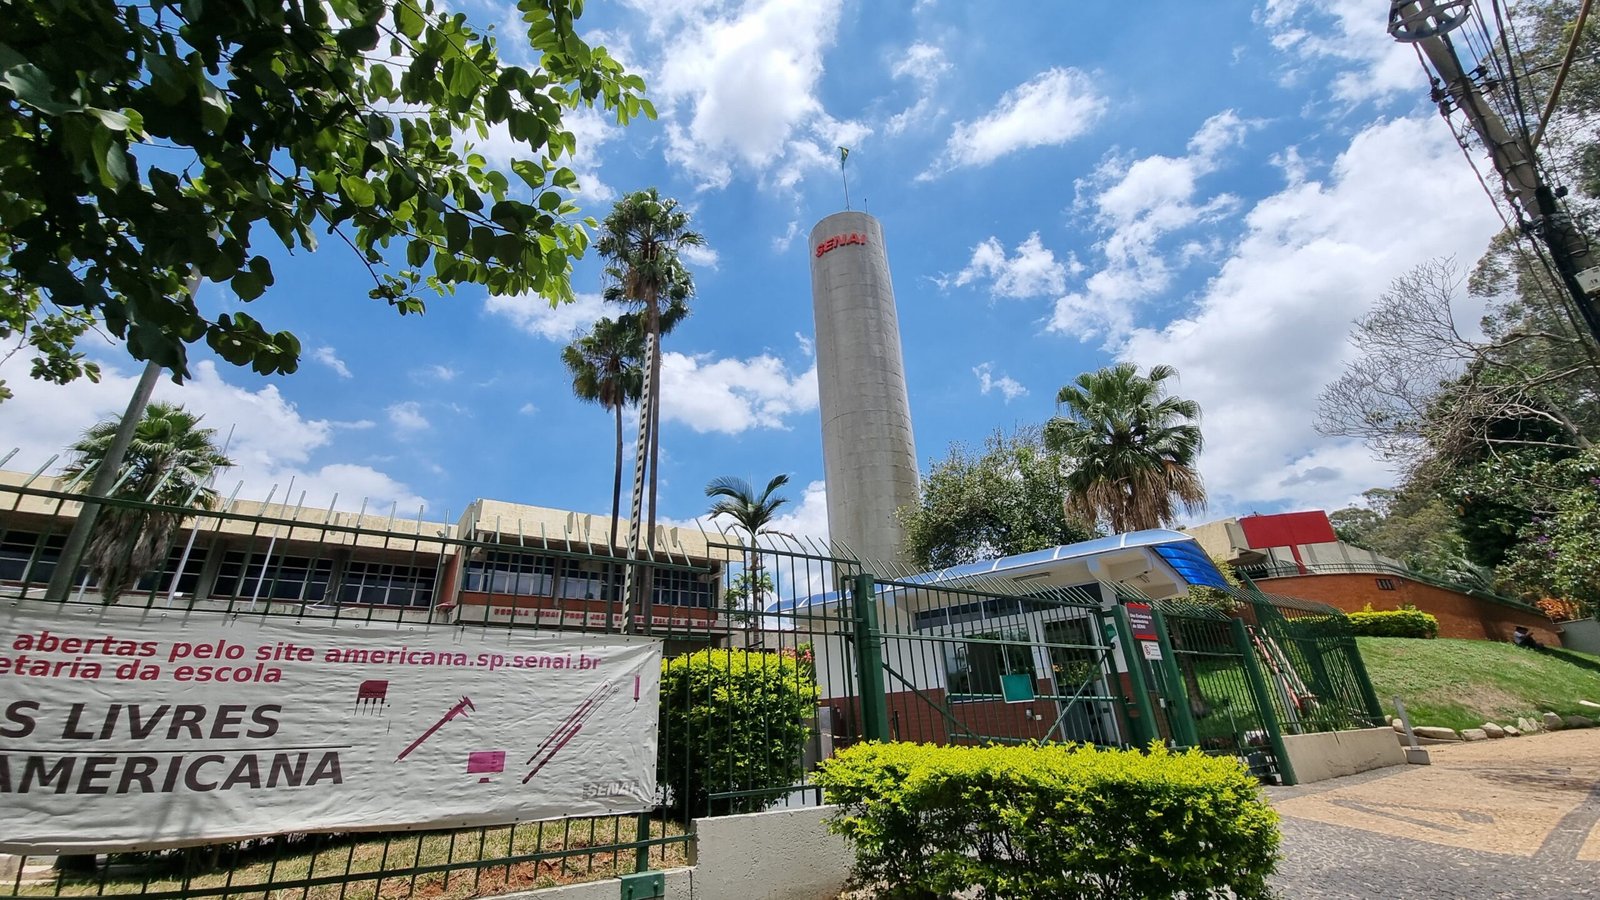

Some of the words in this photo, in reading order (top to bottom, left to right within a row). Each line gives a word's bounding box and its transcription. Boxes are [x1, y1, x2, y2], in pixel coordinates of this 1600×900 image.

[815, 231, 867, 258] SENAI
[12, 630, 157, 657] abertas
[168, 639, 245, 663] pelo
[256, 642, 314, 662] site
[324, 646, 602, 671] americana.sp.senai.br
[115, 659, 160, 681] da
[173, 663, 282, 683] escola
[61, 703, 282, 740] LIVRES
[587, 780, 637, 797] SENAI
